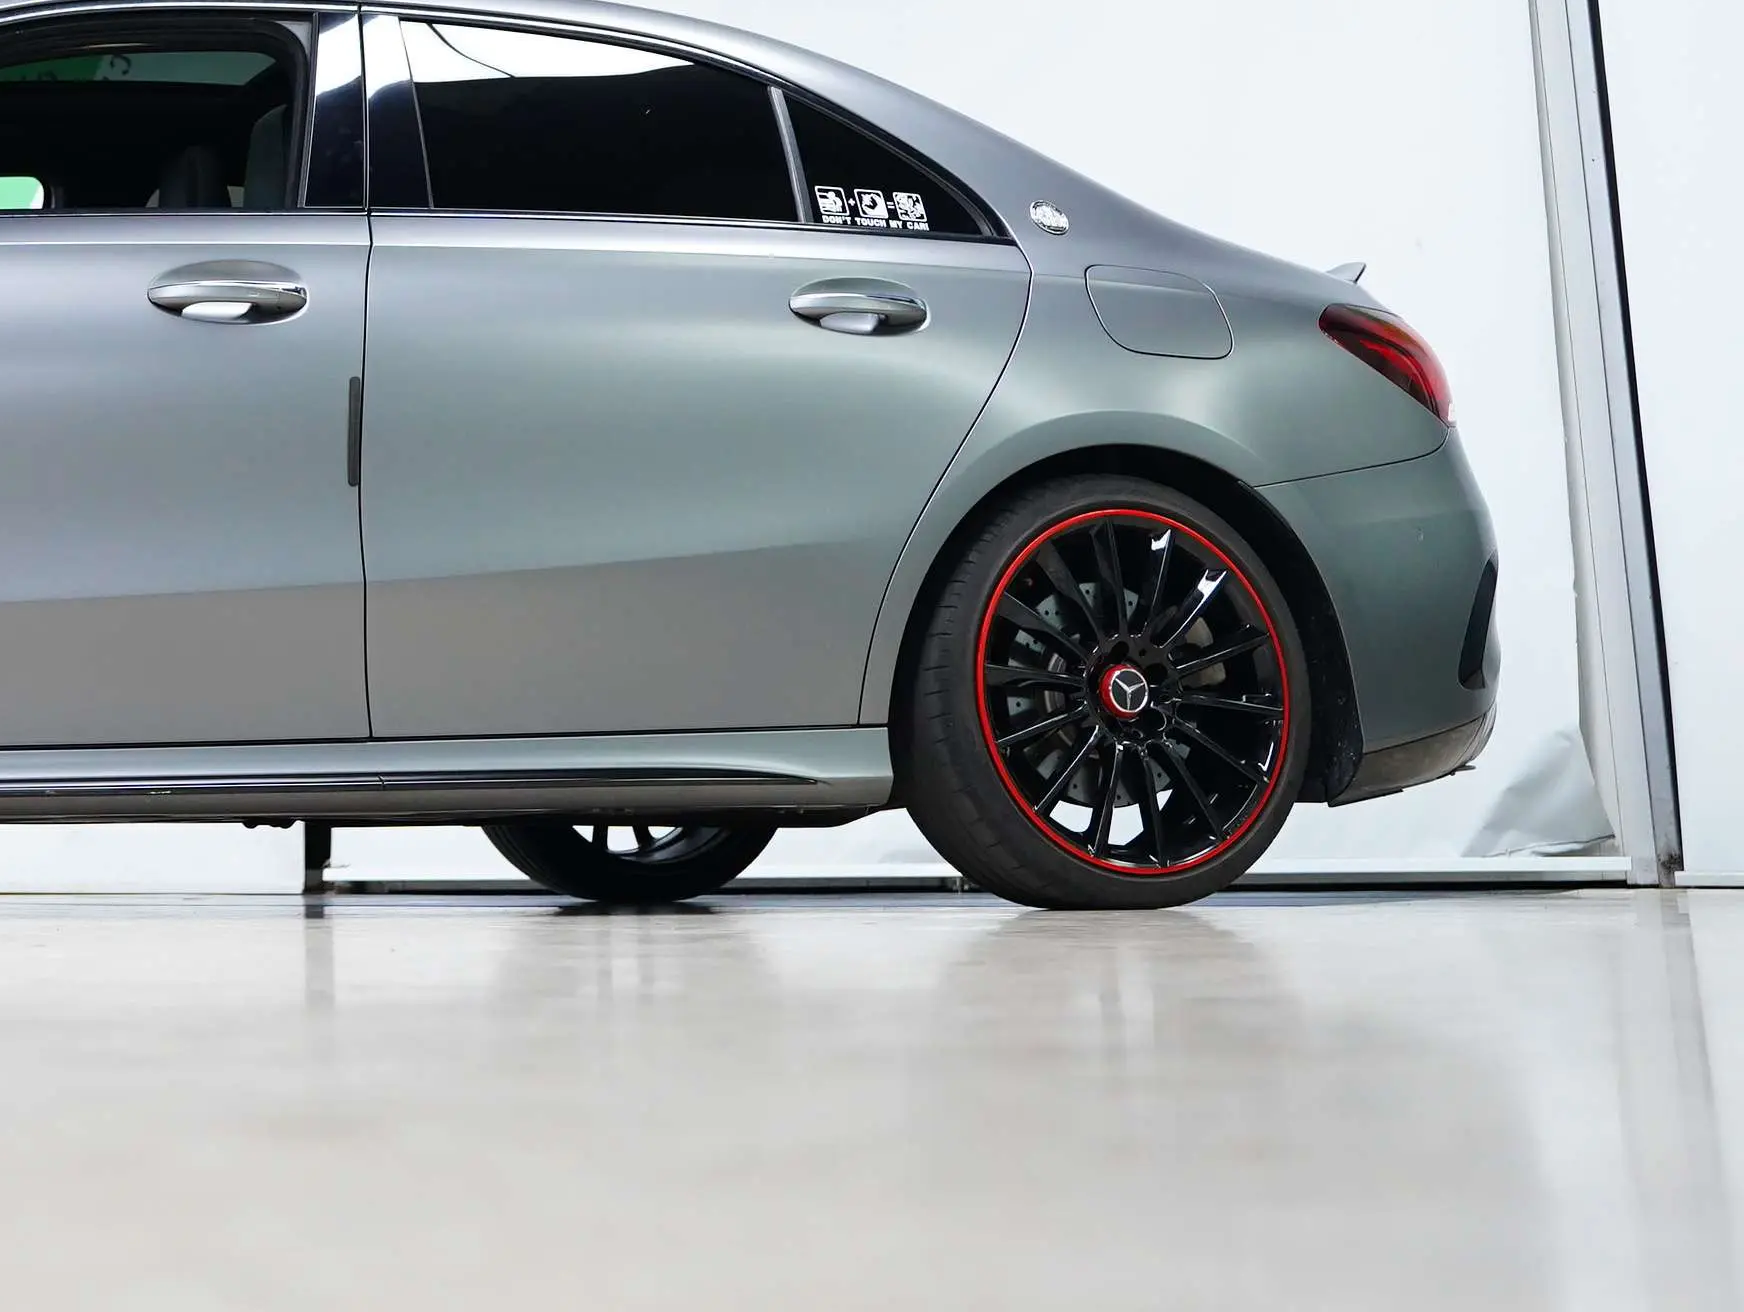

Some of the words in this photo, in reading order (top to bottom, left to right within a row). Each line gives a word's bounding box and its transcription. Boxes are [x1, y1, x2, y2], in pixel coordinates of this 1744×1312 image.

[821, 214, 852, 226] DON'T
[854, 216, 887, 228] TOUCH
[888, 219, 903, 229] MY
